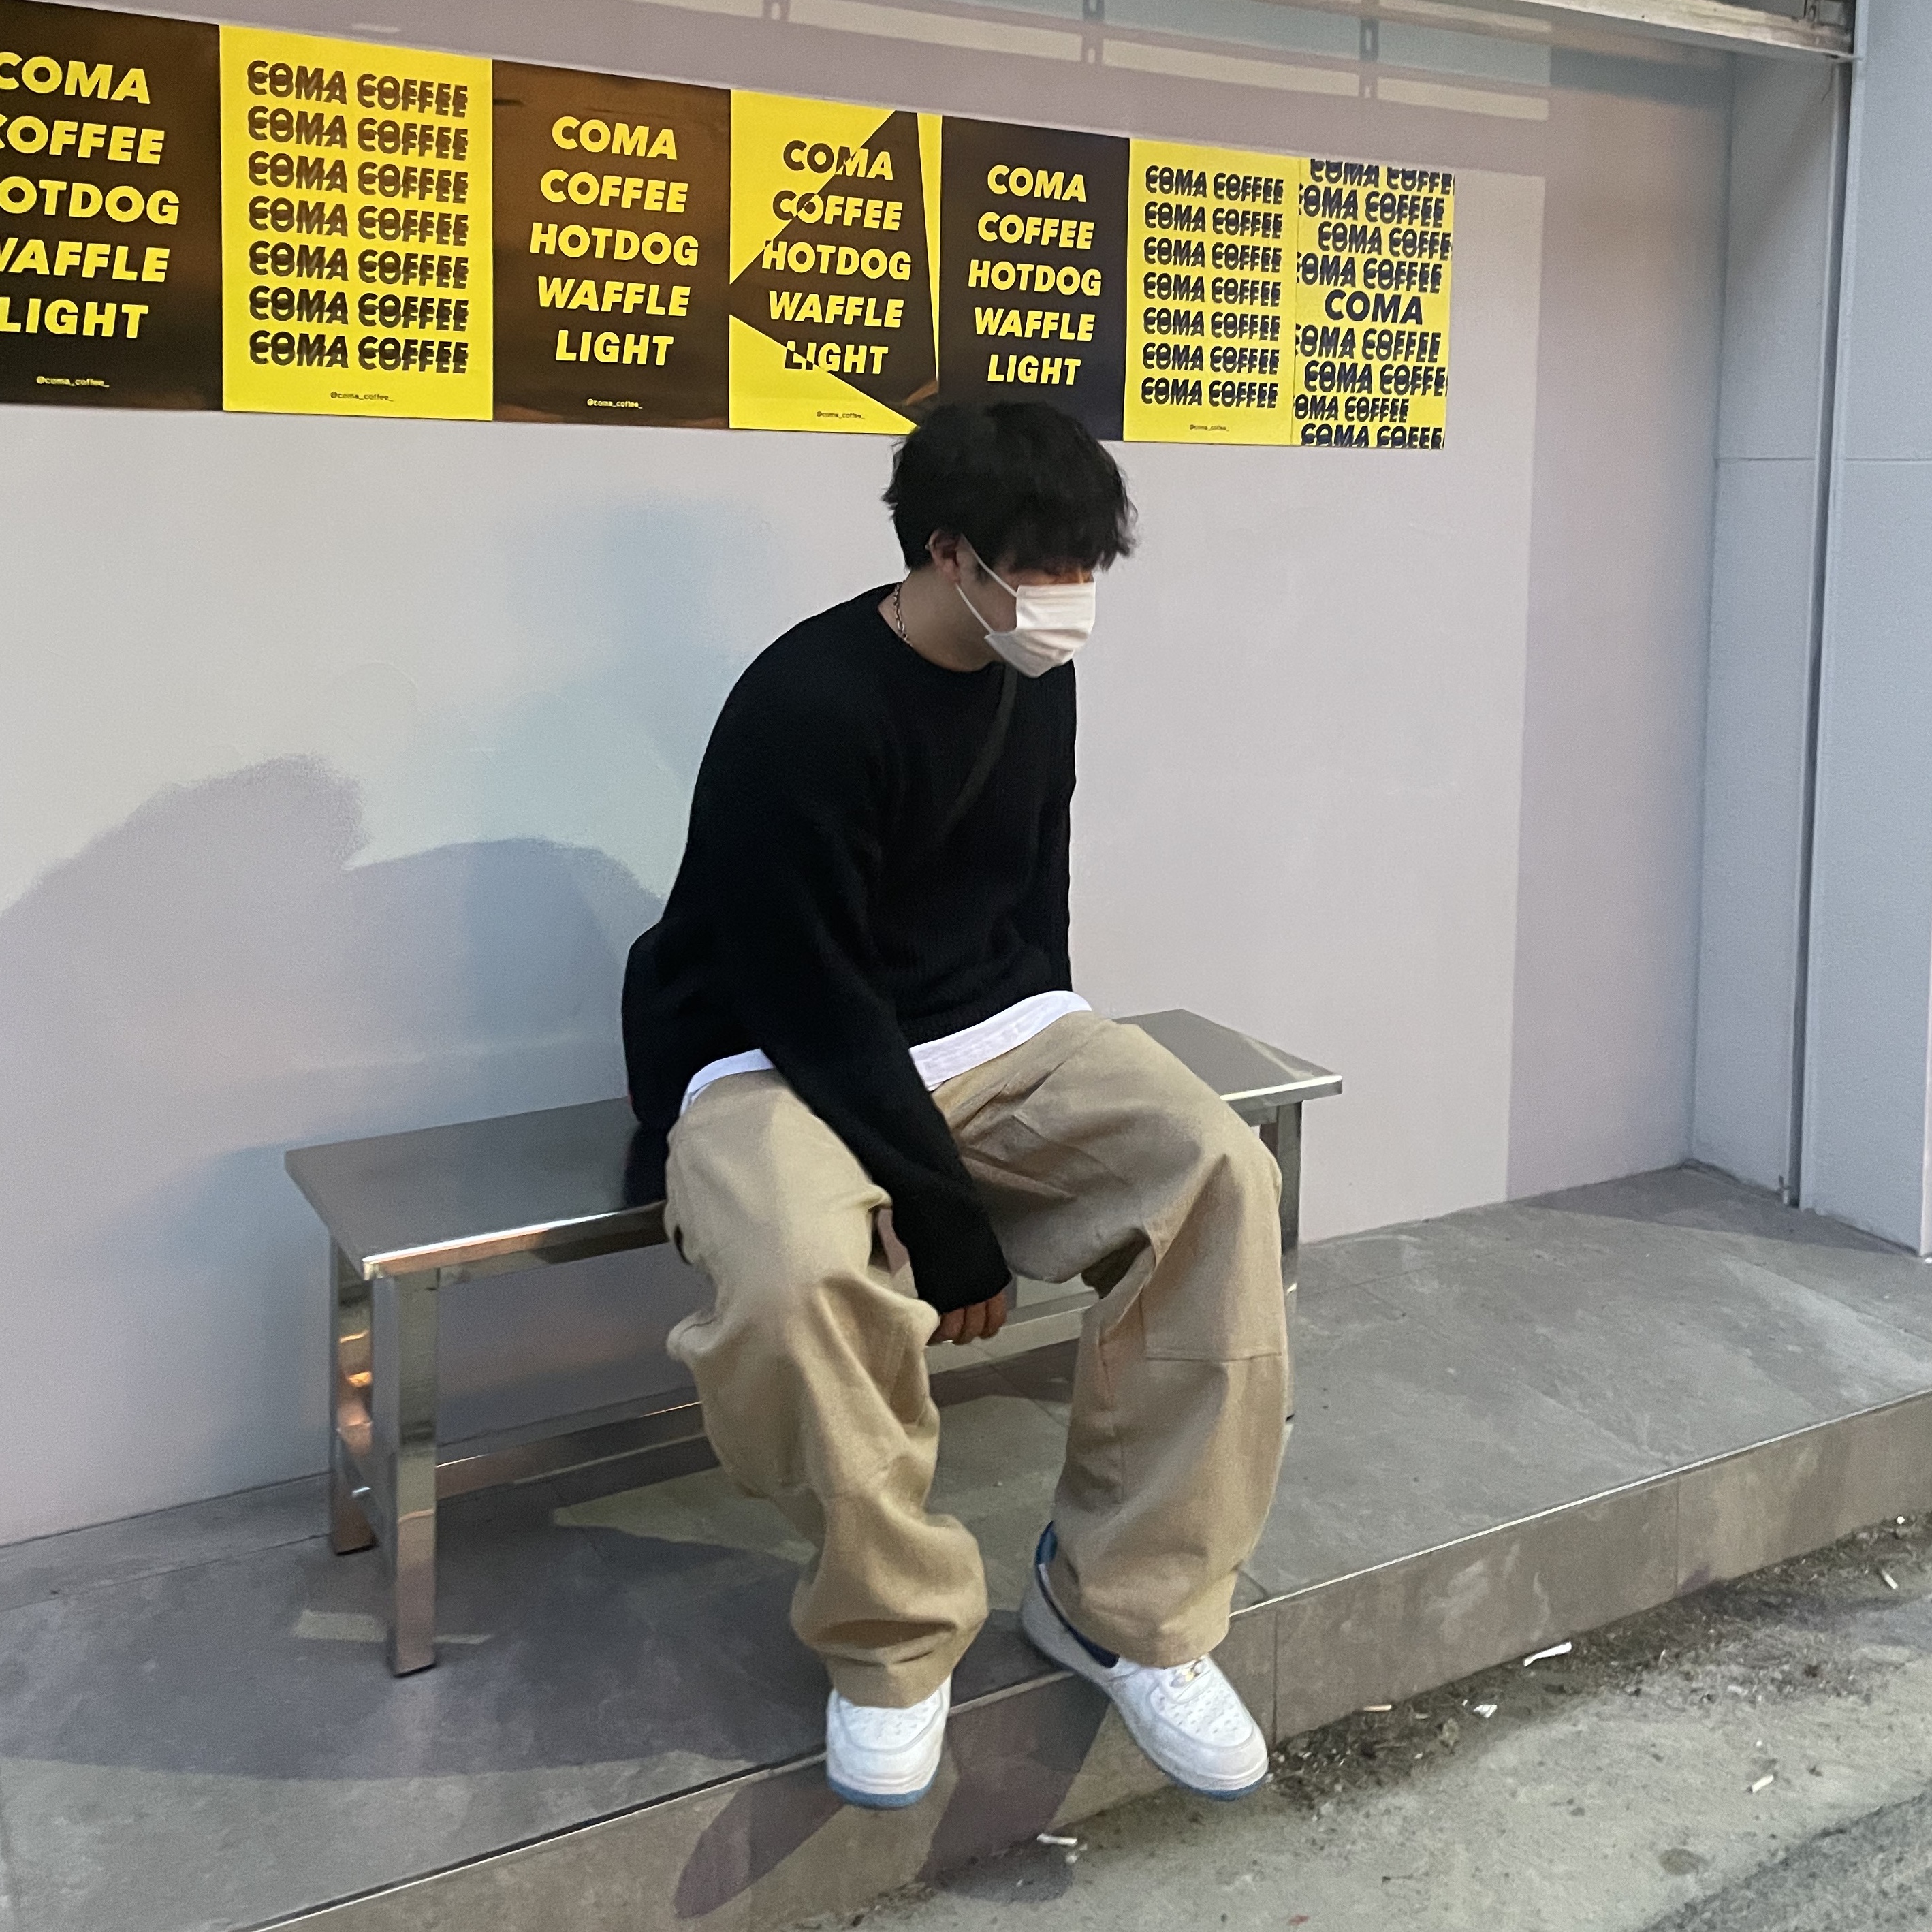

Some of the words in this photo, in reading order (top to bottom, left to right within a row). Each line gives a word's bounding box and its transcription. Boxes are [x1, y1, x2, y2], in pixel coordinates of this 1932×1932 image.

[0, 52, 151, 104] COMA
[247, 60, 347, 105] COMA
[356, 73, 468, 118] COFFEE
[0, 114, 165, 165] OFFEE
[247, 105, 347, 149] COMA
[357, 117, 469, 161] COFFEE
[552, 116, 678, 161] COMA
[248, 151, 348, 193] COMA
[357, 161, 469, 204] COFFEE
[783, 140, 893, 180] COMA
[1310, 158, 1380, 189] COMA
[1387, 166, 1455, 196] COFFE
[0, 176, 180, 225] OTDOG
[540, 169, 689, 213] COFFEE
[987, 164, 1086, 202] COMA
[1145, 165, 1207, 198] COMA
[1213, 172, 1284, 205] COFFEE
[248, 195, 348, 238] COMA
[358, 205, 469, 247] COFFEE
[772, 190, 903, 231] COFFEE
[1144, 201, 1206, 233] COMA
[1212, 207, 1284, 239] COFFEE
[1298, 182, 1359, 221] OMA
[1365, 190, 1445, 229] COFFEE
[530, 222, 699, 266] HOTDOG
[977, 212, 1094, 249] COFFEE
[1318, 221, 1382, 255] COMA
[1389, 227, 1453, 261] COFFE
[249, 240, 349, 281] COMA
[358, 249, 469, 289] COFFEE
[762, 240, 912, 280] HOTDOG
[1143, 236, 1205, 268] COMA
[1211, 242, 1282, 273] COFFEE
[1297, 251, 1356, 288] OMA
[1363, 257, 1442, 294] COFFEE
[537, 276, 691, 317] WAFFLE
[968, 259, 1101, 296] HOTDOG
[1143, 272, 1205, 303] COMA
[1211, 276, 1282, 307] COFFEE
[0, 296, 149, 338] LIGHT
[249, 285, 349, 325] COMA
[358, 292, 469, 332] COFFEE
[769, 290, 904, 328] WAFFLE
[975, 306, 1095, 341] WAFFLE
[1143, 306, 1205, 337] COMA
[1210, 311, 1280, 341] COFFEE
[1324, 289, 1423, 326] COMA
[249, 330, 349, 368] COMA
[358, 336, 469, 374] COFFEE
[555, 330, 674, 366] LIGHT
[784, 341, 889, 375] LIGHT
[1143, 342, 1204, 371] COMA
[1209, 345, 1280, 375] COFFEE
[1361, 328, 1442, 363] COFFEE
[987, 354, 1081, 385] LIGHT
[1303, 360, 1373, 394] COMA
[1379, 364, 1448, 397] COFFE
[1141, 377, 1203, 406] COMA
[1208, 379, 1279, 409] COFFEE
[1293, 394, 1339, 421] OMA
[1344, 396, 1410, 423] COFFEE
[1301, 422, 1369, 447] COMA
[1376, 425, 1445, 449] COFFE
